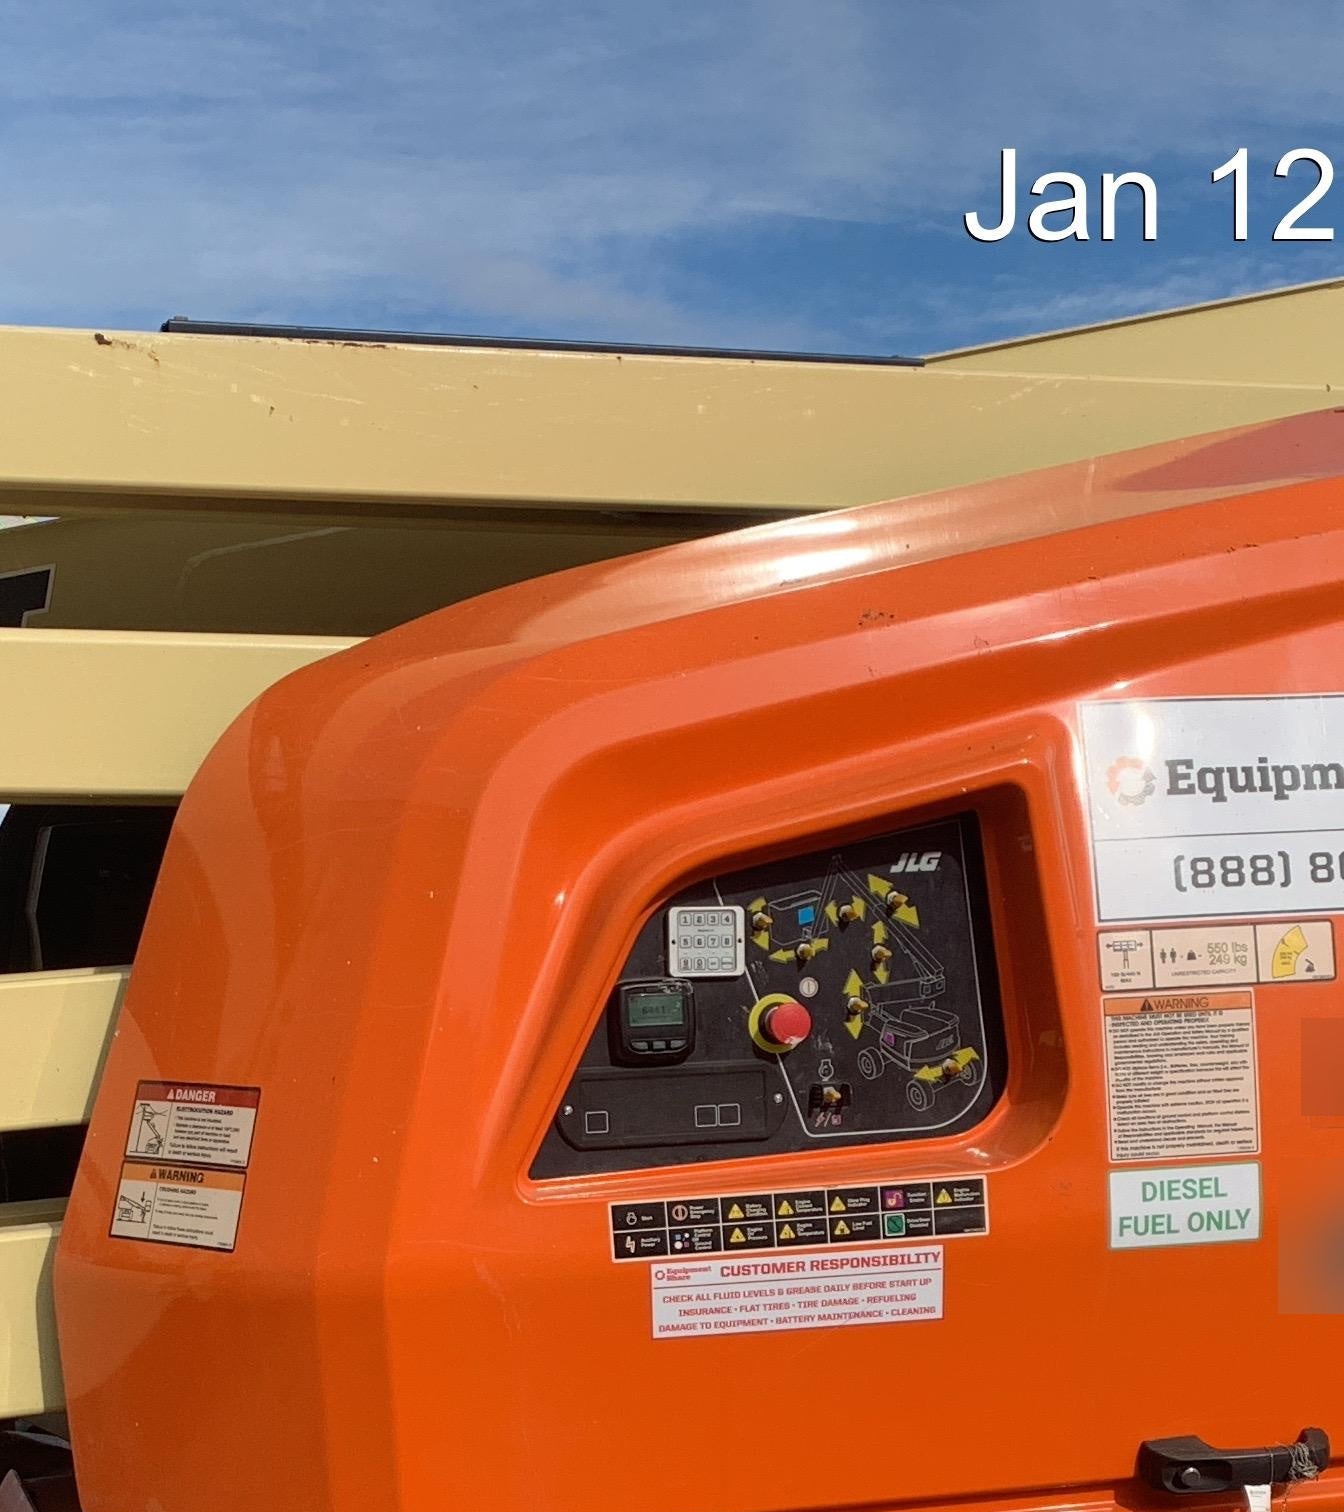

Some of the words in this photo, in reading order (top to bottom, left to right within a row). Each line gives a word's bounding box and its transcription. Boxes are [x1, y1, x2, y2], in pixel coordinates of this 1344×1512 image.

[889, 851, 942, 873] JLG
[1174, 850, 1292, 892] (888)
[1207, 942, 1229, 954] 550
[1232, 941, 1248, 953] lbs
[1209, 954, 1230, 965] 249
[1234, 953, 1248, 967] kg
[1154, 997, 1209, 1009] WARNING
[175, 1089, 216, 1102] DANGER
[158, 1170, 204, 1183] WARNING
[1141, 1176, 1228, 1202] DIESEL
[1118, 1213, 1180, 1237] FUEL
[1187, 1208, 1251, 1233] ONLY
[666, 1265, 712, 1275] Equipment
[720, 1261, 805, 1278] CUSTOMER
[810, 1251, 941, 1272] RESPONSIBILITY
[663, 1294, 694, 1303] CHECK
[695, 1293, 711, 1301] ALL
[713, 1291, 741, 1300] FLUID
[743, 1289, 776, 1298] LEVELS
[786, 1286, 822, 1295] GREASE
[823, 1283, 850, 1293] DAILY
[852, 1281, 887, 1291] BEFORE
[889, 1279, 918, 1288] START
[919, 1278, 932, 1286] UP
[678, 1305, 734, 1317] INSURANCE
[739, 1304, 761, 1313] FLAT
[762, 1302, 790, 1311] TIRES
[797, 1301, 819, 1309] TIRE
[821, 1297, 859, 1307] DAMAGE
[866, 1293, 917, 1304] REFUELING
[658, 1322, 697, 1333] DAMAGE
[699, 1321, 711, 1329] TO
[713, 1318, 769, 1329] EQUIPMENT
[776, 1315, 816, 1325] BATTERY
[891, 1306, 936, 1316] CLEANING
